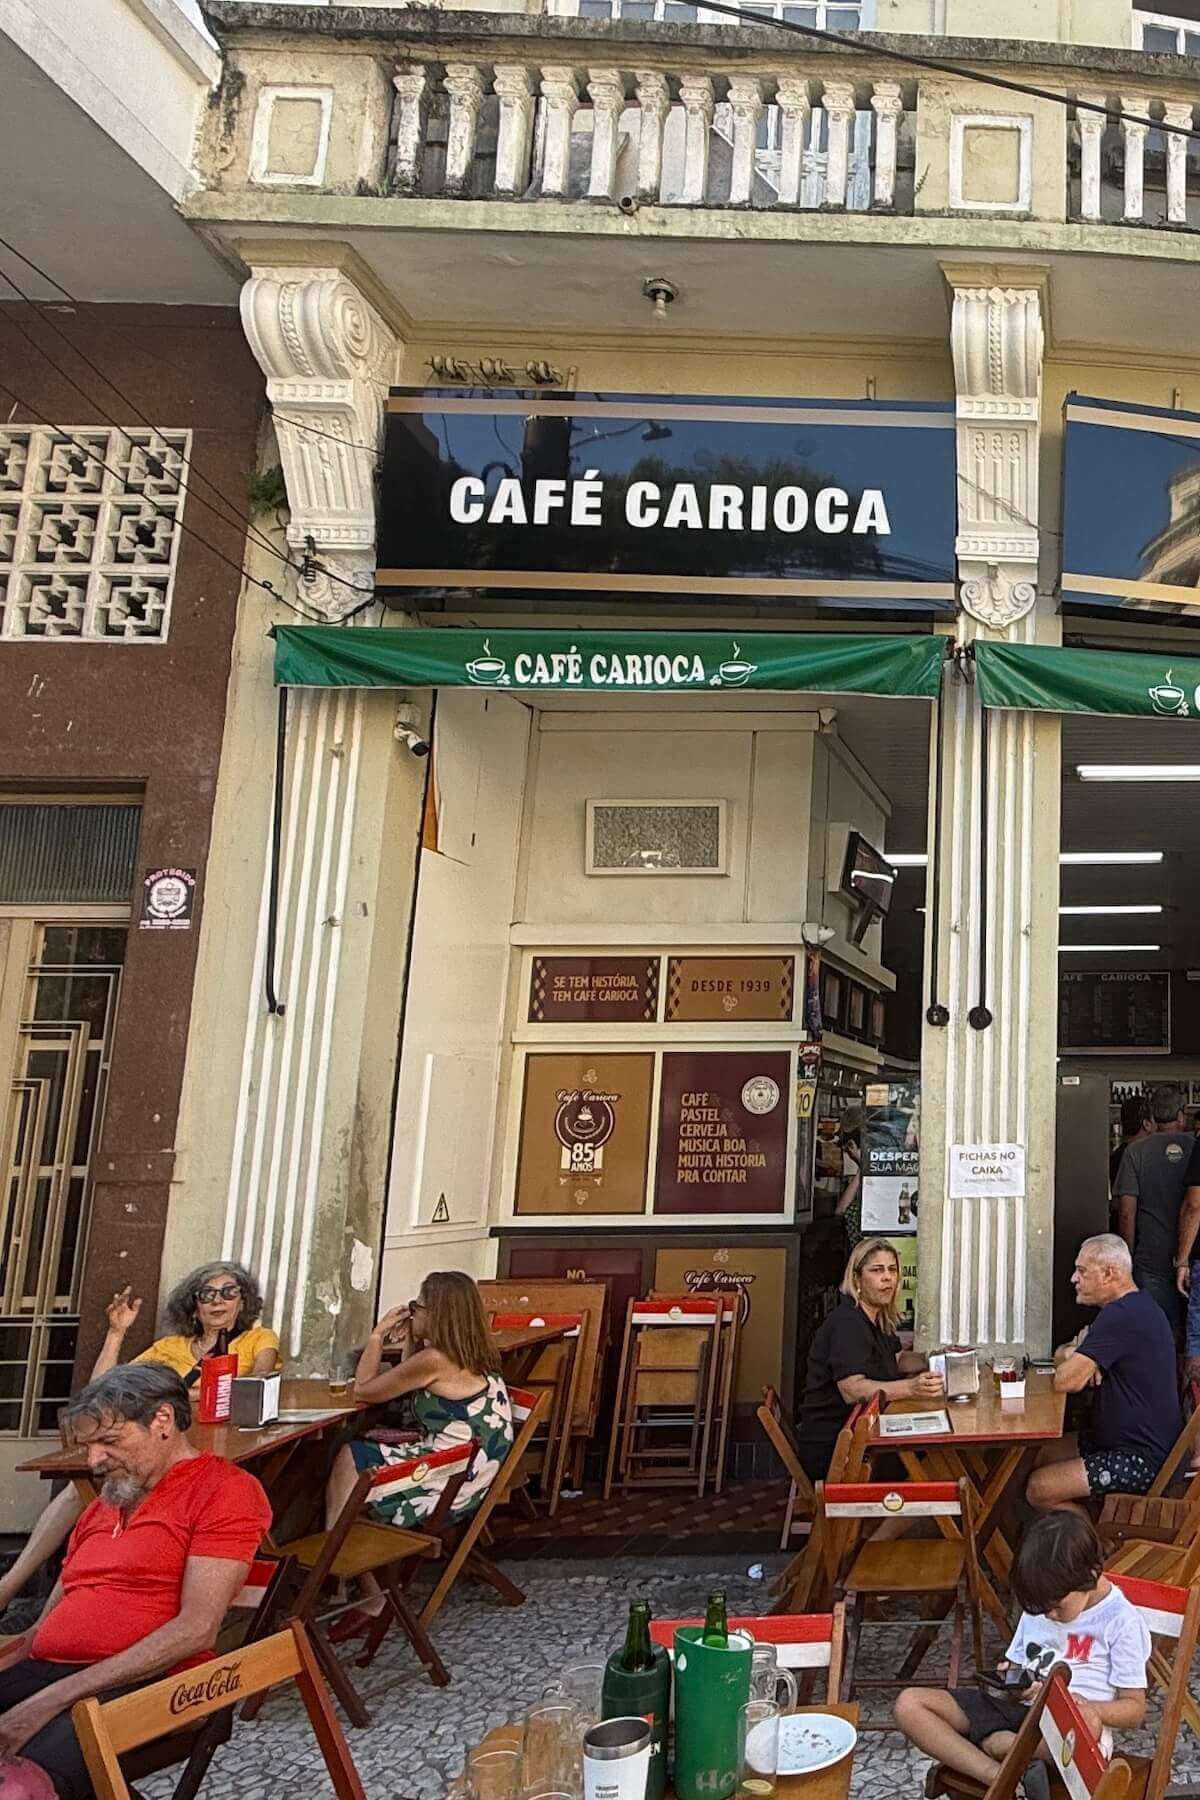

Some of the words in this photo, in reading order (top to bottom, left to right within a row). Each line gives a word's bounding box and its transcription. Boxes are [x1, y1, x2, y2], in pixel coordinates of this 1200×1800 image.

[450, 470, 603, 526] CAFÉ
[625, 481, 891, 534] CARIOCA
[514, 645, 584, 684] CAFÉ
[590, 654, 705, 684] CARIOCA
[553, 975, 566, 987] SE
[569, 975, 589, 987] TEM
[691, 979, 733, 992] DESDE
[740, 979, 771, 992] 1939
[552, 990, 571, 1001] TEM
[599, 990, 639, 1001] CARIOCA
[681, 1091, 709, 1106] CAFÉ
[680, 1108, 720, 1120] PASTEL
[680, 1123, 728, 1136] CERVEJA
[723, 1138, 747, 1152] BOA
[572, 1142, 595, 1162] 85
[959, 1152, 997, 1161] FICHAS
[1000, 1151, 1016, 1161] NO
[571, 1162, 593, 1172] ANOS
[678, 1154, 713, 1167] MUITA
[869, 1162, 892, 1172] SUA
[677, 1169, 700, 1183] PRA
[702, 1169, 747, 1183] CONTAR
[971, 1166, 1004, 1175] CAIXA
[684, 1270, 710, 1289] Café
[713, 1270, 754, 1284] Carioca
[215, 1373, 233, 1418] BRAHMA
[1064, 1632, 1094, 1662] M
